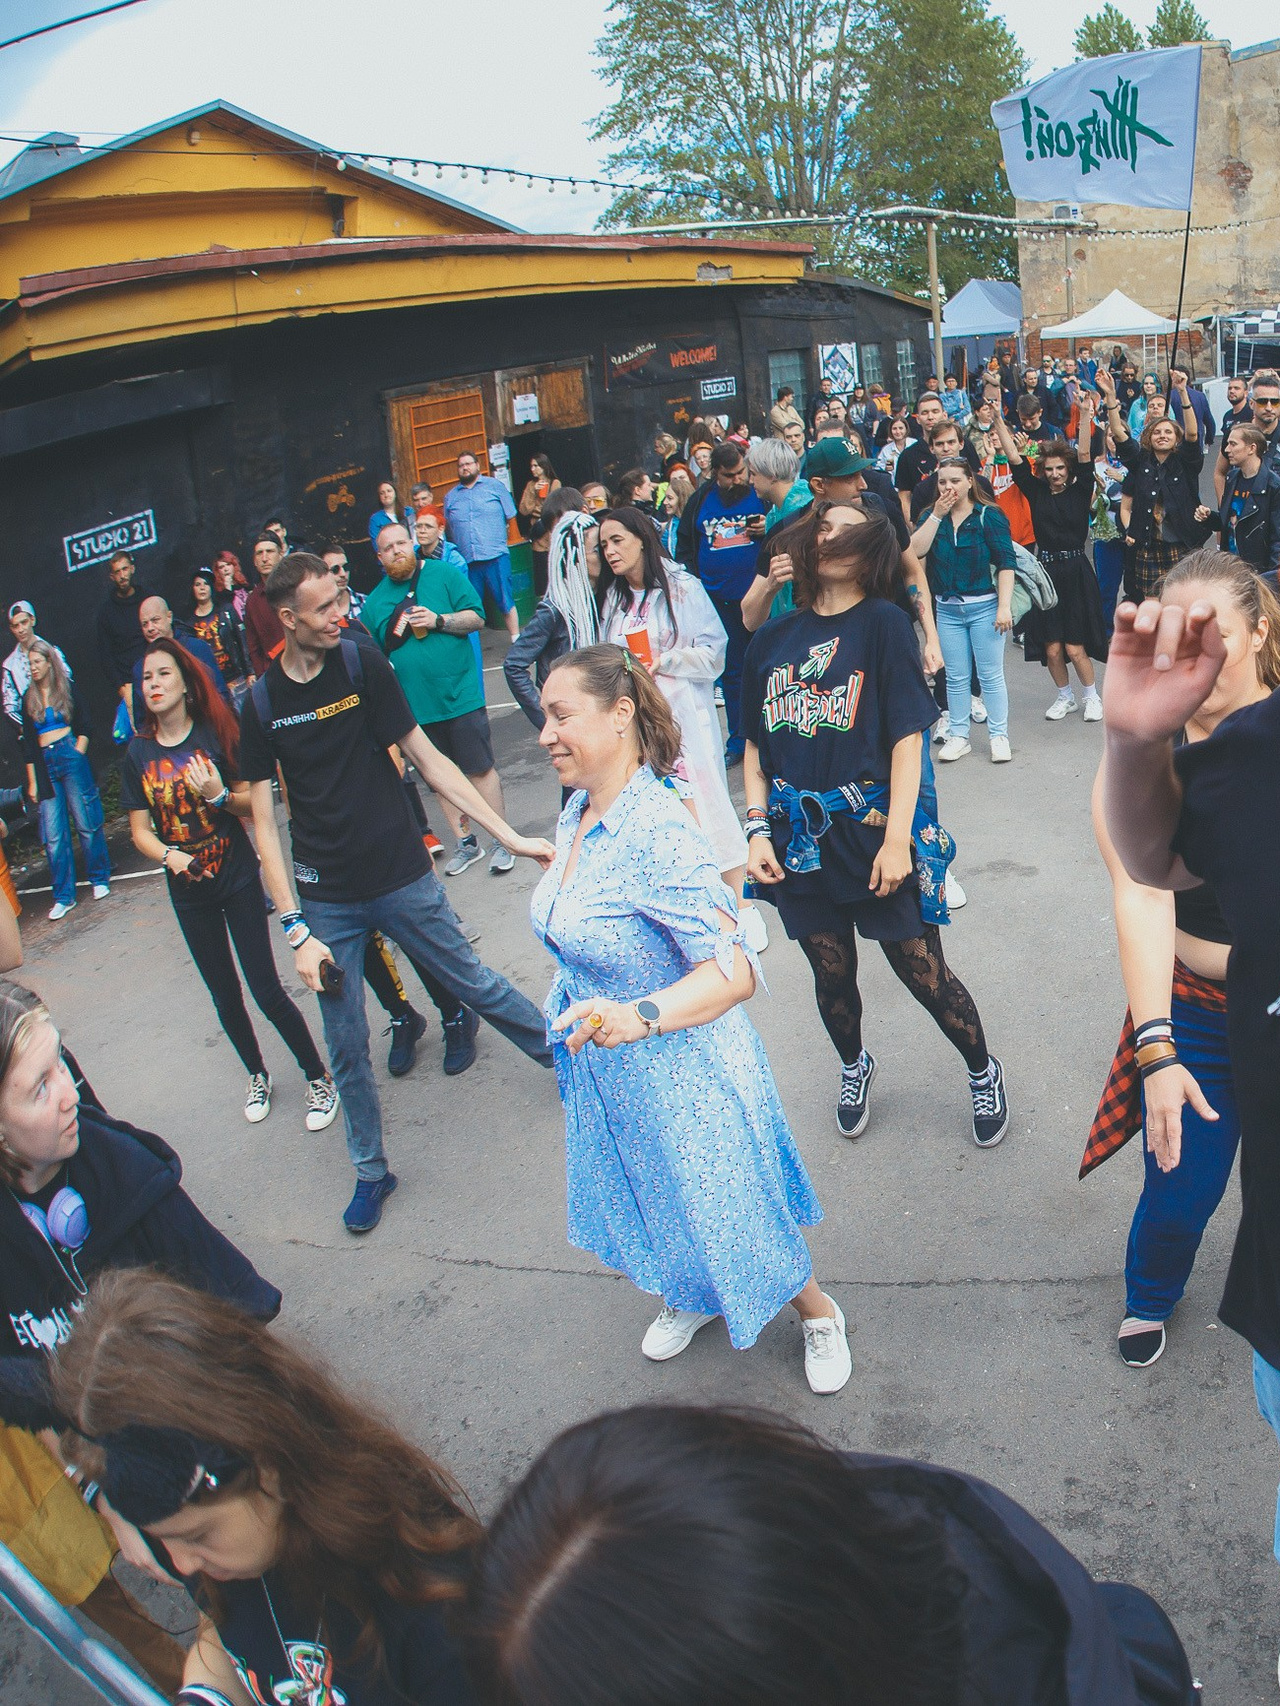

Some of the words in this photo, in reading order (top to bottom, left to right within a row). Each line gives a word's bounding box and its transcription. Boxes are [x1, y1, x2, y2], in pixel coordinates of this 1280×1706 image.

[669, 344, 718, 368] WELCOME!
[703, 383, 727, 396] STUDIO
[727, 382, 734, 393] 21
[72, 527, 130, 560] STUDIO
[132, 519, 150, 541] 21
[322, 695, 360, 717] KRASIVO
